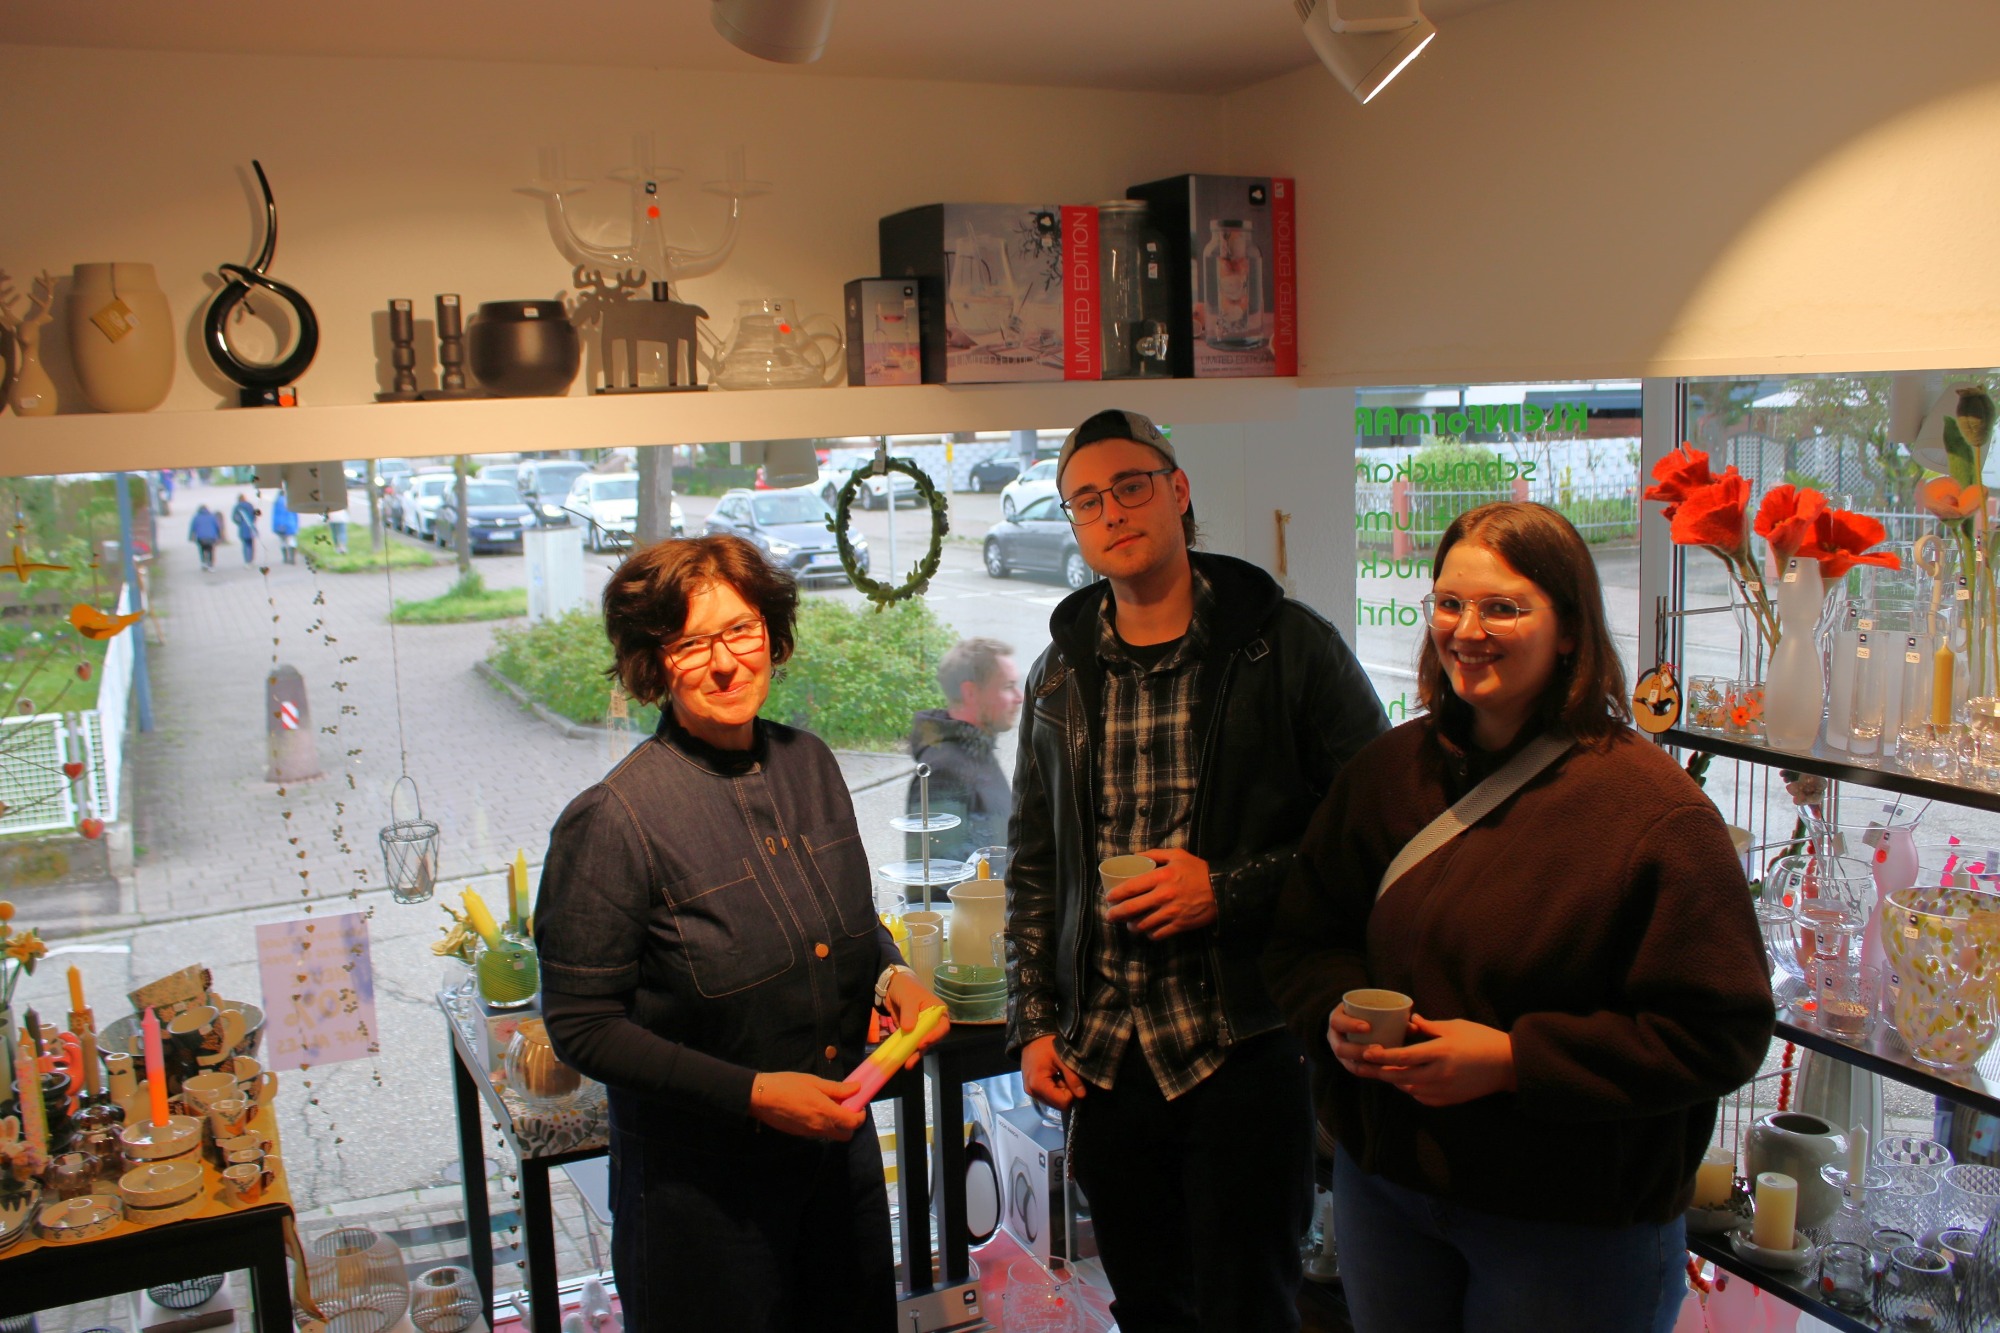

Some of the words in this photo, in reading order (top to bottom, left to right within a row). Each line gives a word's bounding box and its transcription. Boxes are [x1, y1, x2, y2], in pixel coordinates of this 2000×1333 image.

[1072, 212, 1090, 291] EDITION
[1278, 211, 1291, 276] EDITION
[1074, 297, 1091, 374] LIMITED
[1279, 281, 1293, 345] LIMITED
